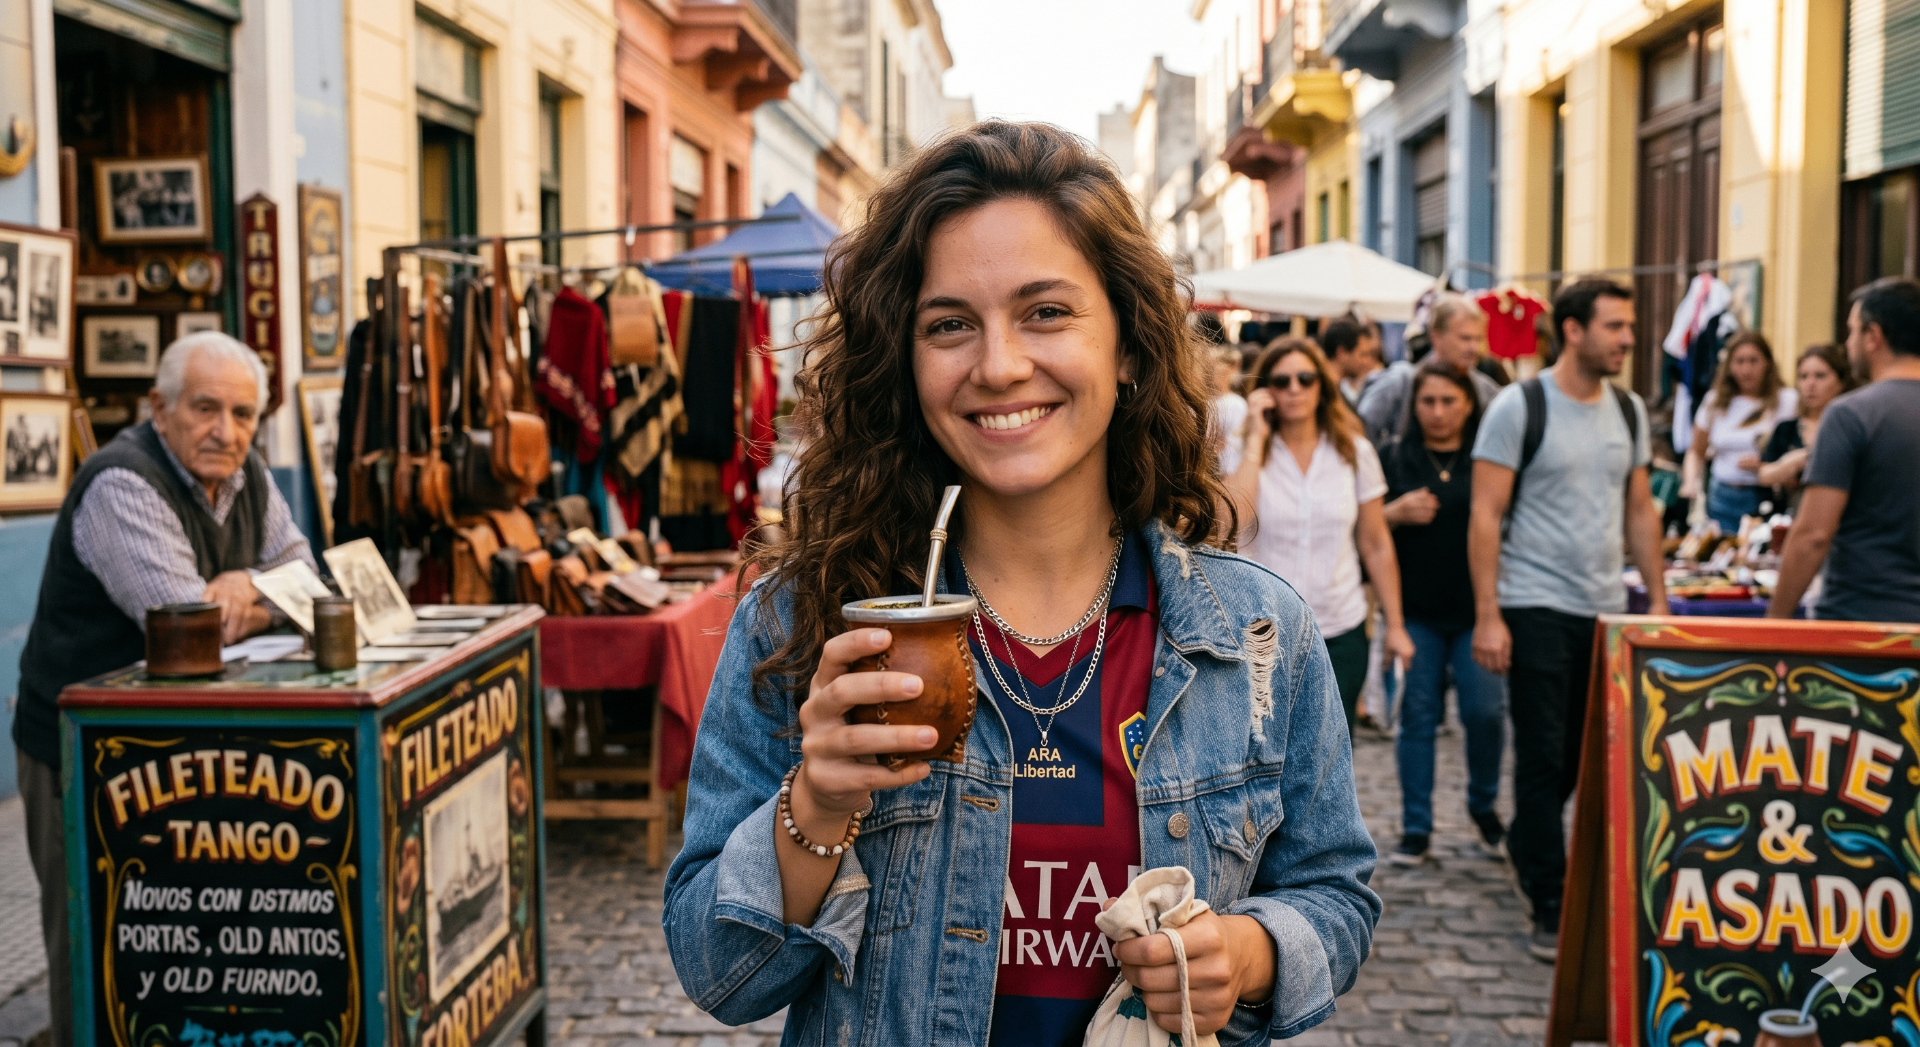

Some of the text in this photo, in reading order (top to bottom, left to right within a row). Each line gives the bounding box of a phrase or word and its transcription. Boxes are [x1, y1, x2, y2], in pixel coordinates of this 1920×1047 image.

[400, 676, 518, 806] FILETEADO
[1027, 747, 1062, 762] ARA
[1014, 763, 1076, 779] Libertad
[1661, 714, 1905, 817] MATE
[104, 749, 346, 828] FILETEADO
[165, 819, 301, 863] TANGO
[1757, 799, 1818, 865] &
[198, 887, 242, 912] CON
[248, 888, 335, 914] DSTMOS
[1003, 860, 1142, 921] TA
[1656, 867, 1914, 958] ASADO
[218, 926, 264, 955] OLD
[1001, 928, 1122, 968] IRWA
[162, 966, 214, 993] OLD
[221, 967, 323, 997] FURNDO.
